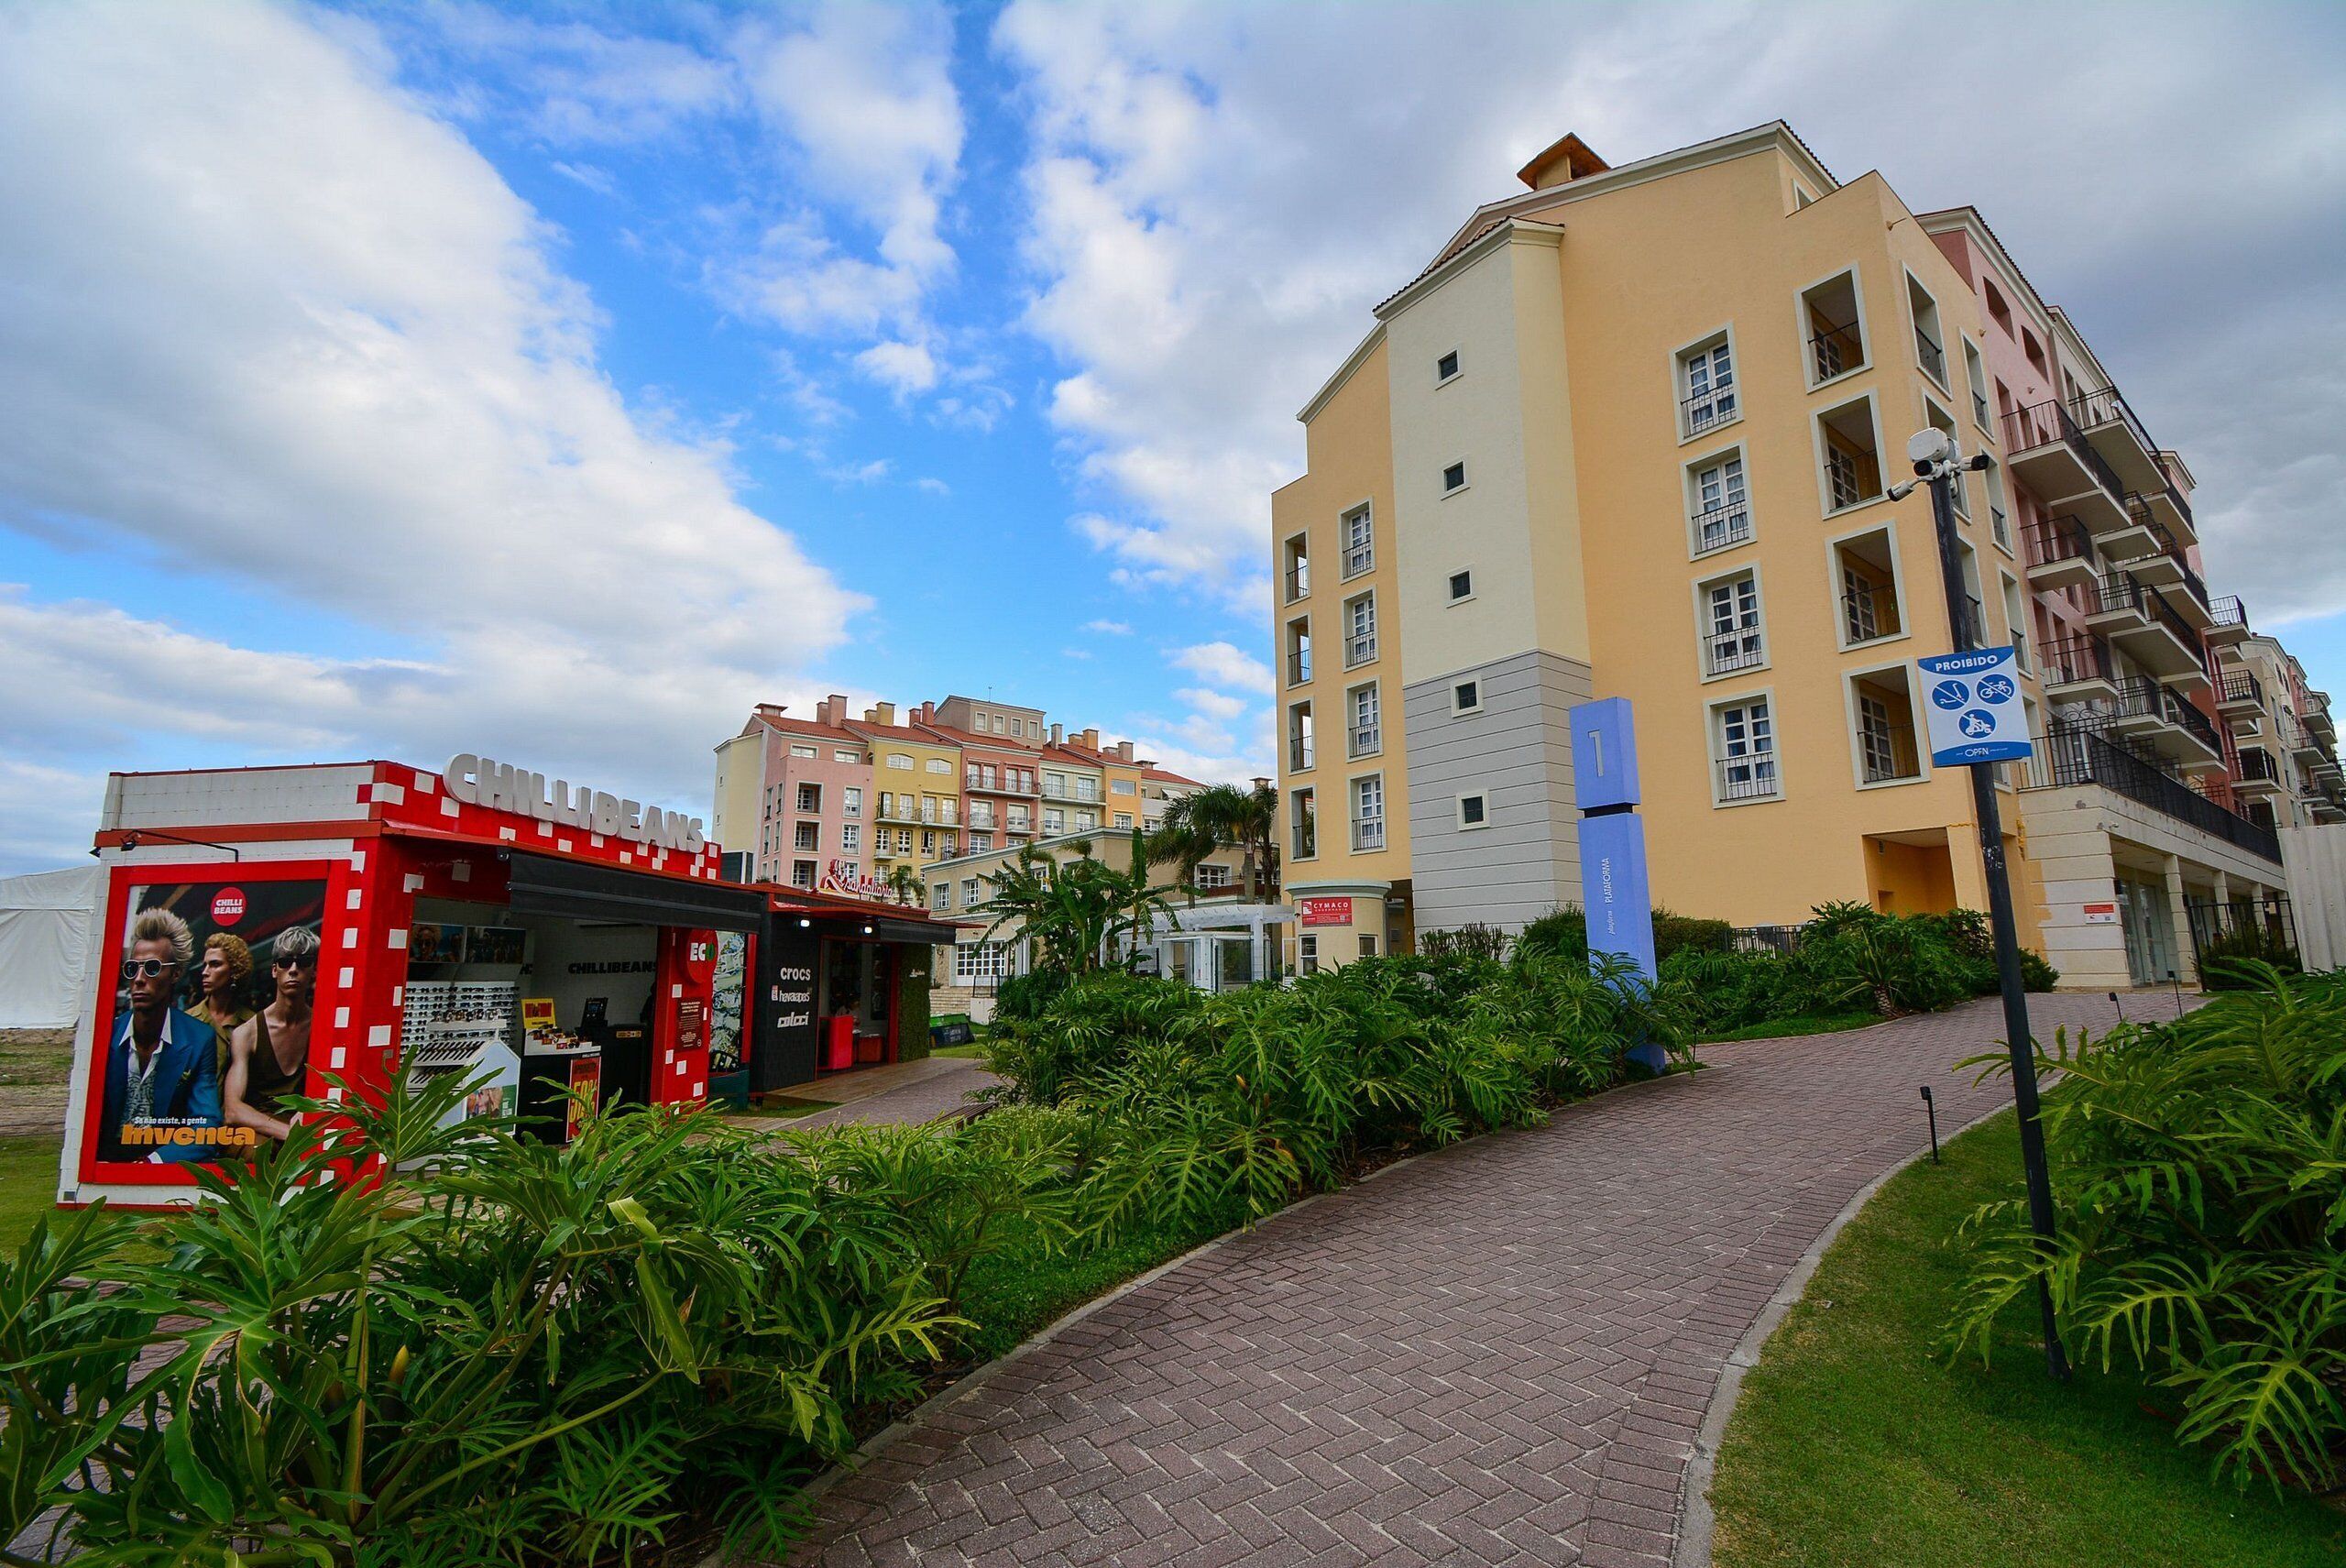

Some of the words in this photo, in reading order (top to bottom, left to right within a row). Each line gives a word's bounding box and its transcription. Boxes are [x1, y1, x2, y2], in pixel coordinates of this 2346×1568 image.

[1935, 654, 1998, 672] PROIBIDO
[1587, 729, 1605, 778] 1
[1965, 747, 1990, 757] OPEN
[1601, 857, 1613, 905] PLATAFORMA
[215, 898, 243, 906] CHILLI
[214, 906, 243, 915] BEANS
[780, 967, 811, 981] crocs
[777, 1011, 810, 1028] colcci
[157, 1116, 181, 1125] existe,
[187, 1116, 207, 1126] gente
